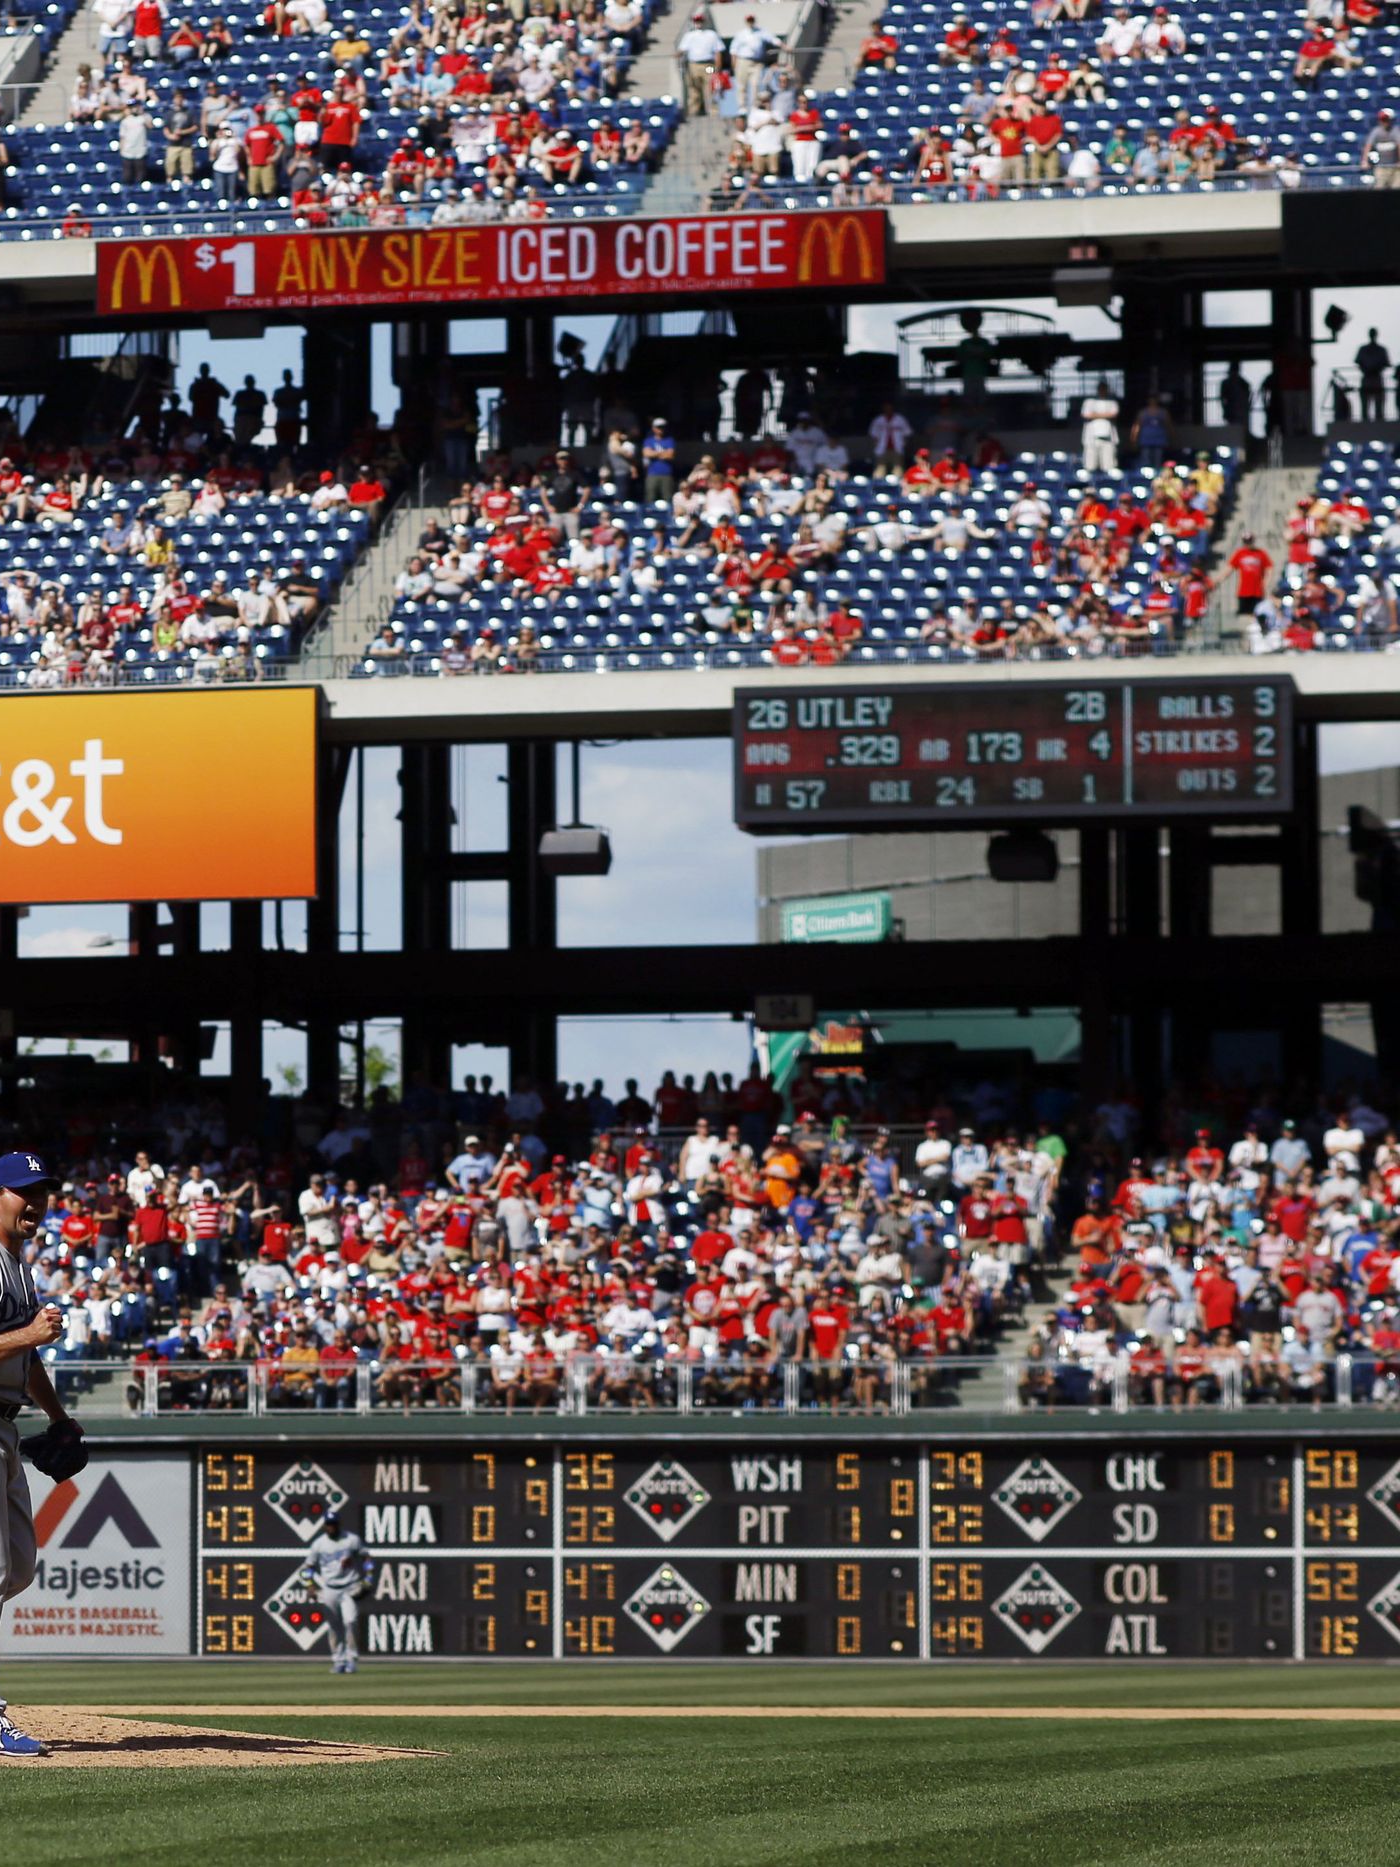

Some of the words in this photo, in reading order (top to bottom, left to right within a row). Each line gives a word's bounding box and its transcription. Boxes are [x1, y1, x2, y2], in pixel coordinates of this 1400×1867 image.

[194, 242, 256, 296] $1
[276, 237, 369, 293] ANY
[382, 231, 482, 290] SIZE
[497, 227, 597, 283] ICED
[615, 219, 788, 279] COFFEE
[748, 700, 789, 729] 26
[797, 697, 893, 727] UTLEY
[1065, 691, 1106, 721] 2B
[1158, 696, 1234, 719] BALLS
[1253, 687, 1276, 717] 3
[826, 735, 900, 766] .329
[967, 732, 1022, 763] 173
[1089, 730, 1111, 760] 4
[1135, 729, 1239, 754] STRIKES
[1253, 726, 1276, 756] 2
[786, 780, 826, 810] 57
[935, 776, 976, 807] 24
[1081, 774, 1097, 803] 1
[1177, 769, 1237, 792] OUTS
[1253, 764, 1276, 795] 2
[26, 1155, 42, 1172] LA
[282, 1478, 328, 1496] OUTS
[373, 1456, 431, 1494] MIL
[473, 1454, 496, 1490] 7
[645, 1479, 691, 1496] OUTS
[730, 1455, 802, 1493] WSH
[836, 1453, 860, 1491] 5
[1014, 1477, 1060, 1496] OUTS
[1105, 1453, 1166, 1492] CHC
[1209, 1451, 1234, 1490] 0
[1306, 1450, 1358, 1489] 50
[525, 1479, 548, 1516] 9
[1279, 1478, 1290, 1514] 1
[206, 1506, 255, 1543] 43
[364, 1505, 437, 1544] MIA
[472, 1505, 496, 1543] 0
[565, 1505, 615, 1543] 32
[738, 1505, 791, 1545] PIT
[851, 1506, 861, 1543] 1
[1112, 1504, 1160, 1544] SD
[1209, 1504, 1235, 1543] 0
[206, 1563, 255, 1600] 43
[375, 1562, 428, 1601] ARI
[473, 1563, 496, 1600] 2
[565, 1563, 615, 1600] 47
[734, 1562, 798, 1603] MIN
[837, 1563, 861, 1601] 0
[931, 1563, 984, 1601] 56
[1014, 1589, 1060, 1607] OUTS
[1104, 1564, 1169, 1604] COL
[1306, 1562, 1359, 1601] 52
[12, 1606, 76, 1619] ALWAYS
[79, 1606, 163, 1620] BASEBALL.
[525, 1589, 548, 1626] 9
[905, 1591, 915, 1628] 1
[12, 1623, 76, 1636] ALWAYS
[79, 1623, 164, 1637] MAJESTIC.
[206, 1615, 255, 1652] 58
[367, 1614, 434, 1653] NYM
[486, 1616, 496, 1652] 1
[565, 1615, 615, 1653] 40
[745, 1615, 782, 1655] SF
[837, 1616, 861, 1653] 0
[1105, 1614, 1168, 1655] ATL
